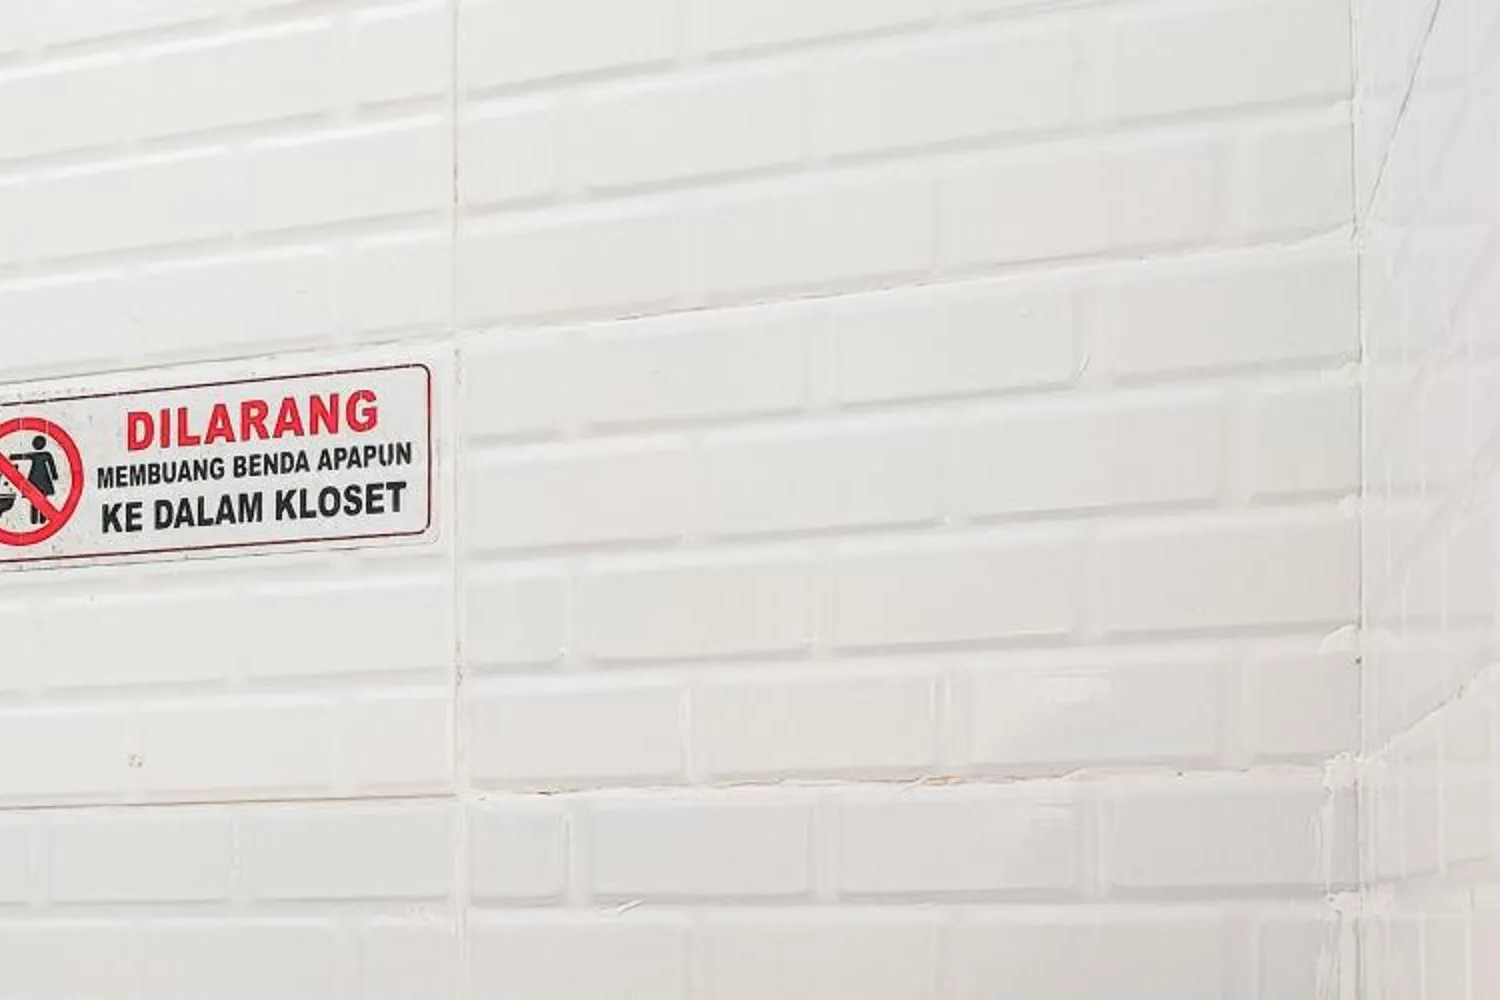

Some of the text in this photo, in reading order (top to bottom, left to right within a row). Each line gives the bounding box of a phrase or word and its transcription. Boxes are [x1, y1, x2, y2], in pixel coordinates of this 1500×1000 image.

[126, 389, 379, 452] DILARANG
[97, 441, 412, 489] MEMBUANG BENDA APAPUN
[101, 481, 407, 534] KE DALAM KLOSET
